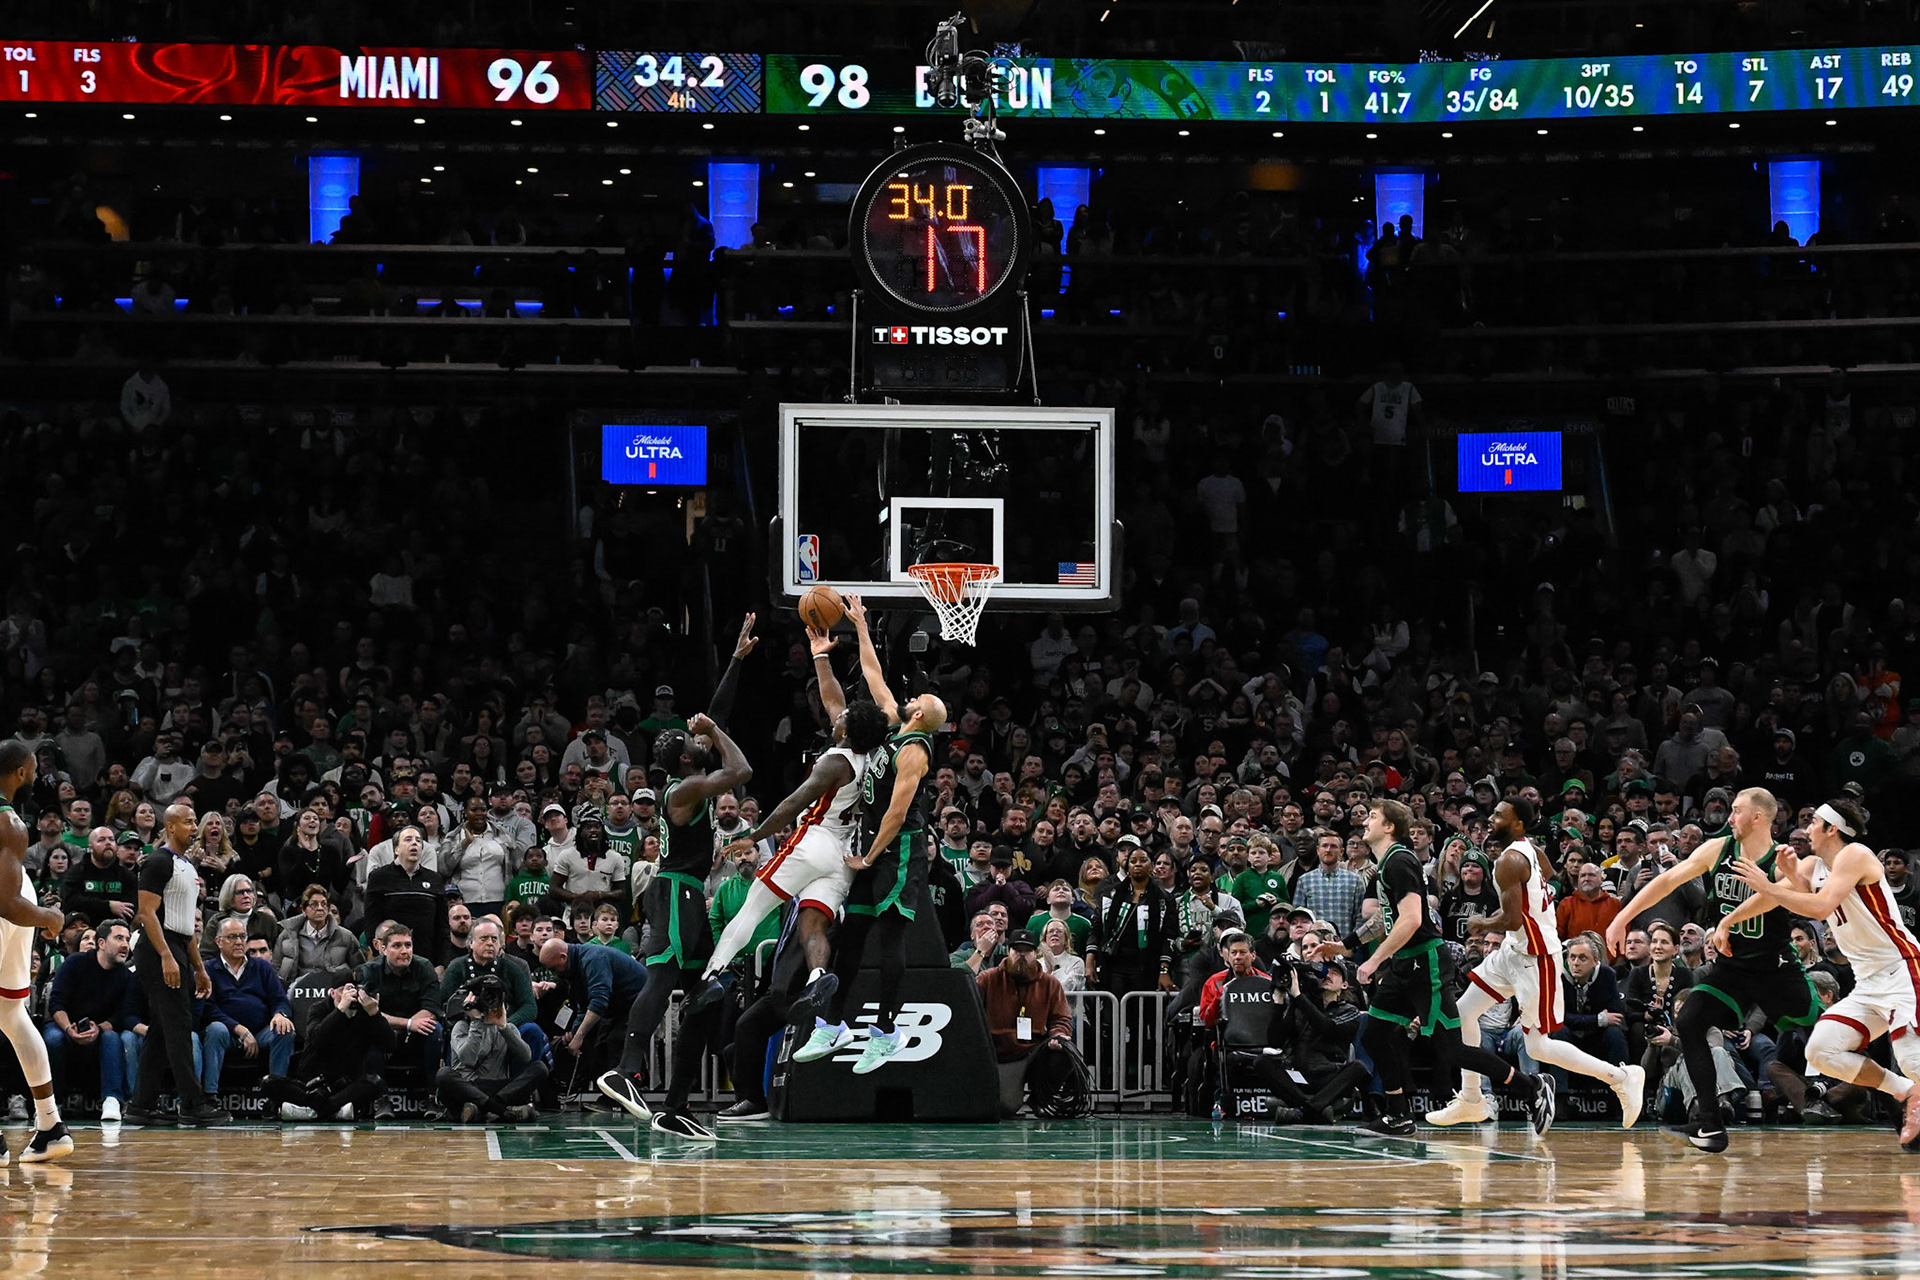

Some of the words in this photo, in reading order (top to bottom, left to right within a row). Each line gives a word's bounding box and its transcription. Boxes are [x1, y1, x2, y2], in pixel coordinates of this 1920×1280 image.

[3, 47, 36, 61] TOL
[73, 48, 101, 63] FLS
[1810, 55, 1841, 69] AST
[1881, 53, 1912, 66] REB
[634, 54, 724, 88] 34.2
[1470, 67, 1492, 81] FG
[1581, 64, 1610, 77] 3PT
[1674, 60, 1698, 74] TO
[1742, 58, 1768, 72] STL
[19, 69, 28, 92] 1
[80, 70, 97, 93] 3
[340, 55, 439, 99] MIAMI
[487, 58, 560, 104] 96
[1248, 68, 1274, 82] FLS
[1305, 70, 1336, 83] TOL
[1369, 70, 1406, 84] FG%
[800, 64, 871, 110] 98
[1675, 82, 1703, 105] 14
[1749, 80, 1765, 102] 7
[1815, 77, 1843, 100] 17
[1882, 74, 1914, 97] 49
[667, 91, 696, 110] 4th
[1255, 90, 1271, 113] 2
[1320, 91, 1328, 113] 1
[1364, 91, 1411, 114] 41.7
[1446, 87, 1519, 113] 35/84
[1563, 83, 1634, 109] 10/35
[888, 184, 968, 220] 34.0
[927, 225, 985, 292] 17
[911, 326, 1008, 345] TISSOT
[1385, 406, 1394, 418] 5
[633, 434, 672, 446] Michelob
[1488, 442, 1528, 453] Michelob
[626, 446, 683, 459] ULTRA
[1481, 453, 1538, 466] ULTRA
[518, 881, 550, 896] CELTICS
[295, 987, 331, 999] PIM
[214, 1094, 269, 1112] etBlue
